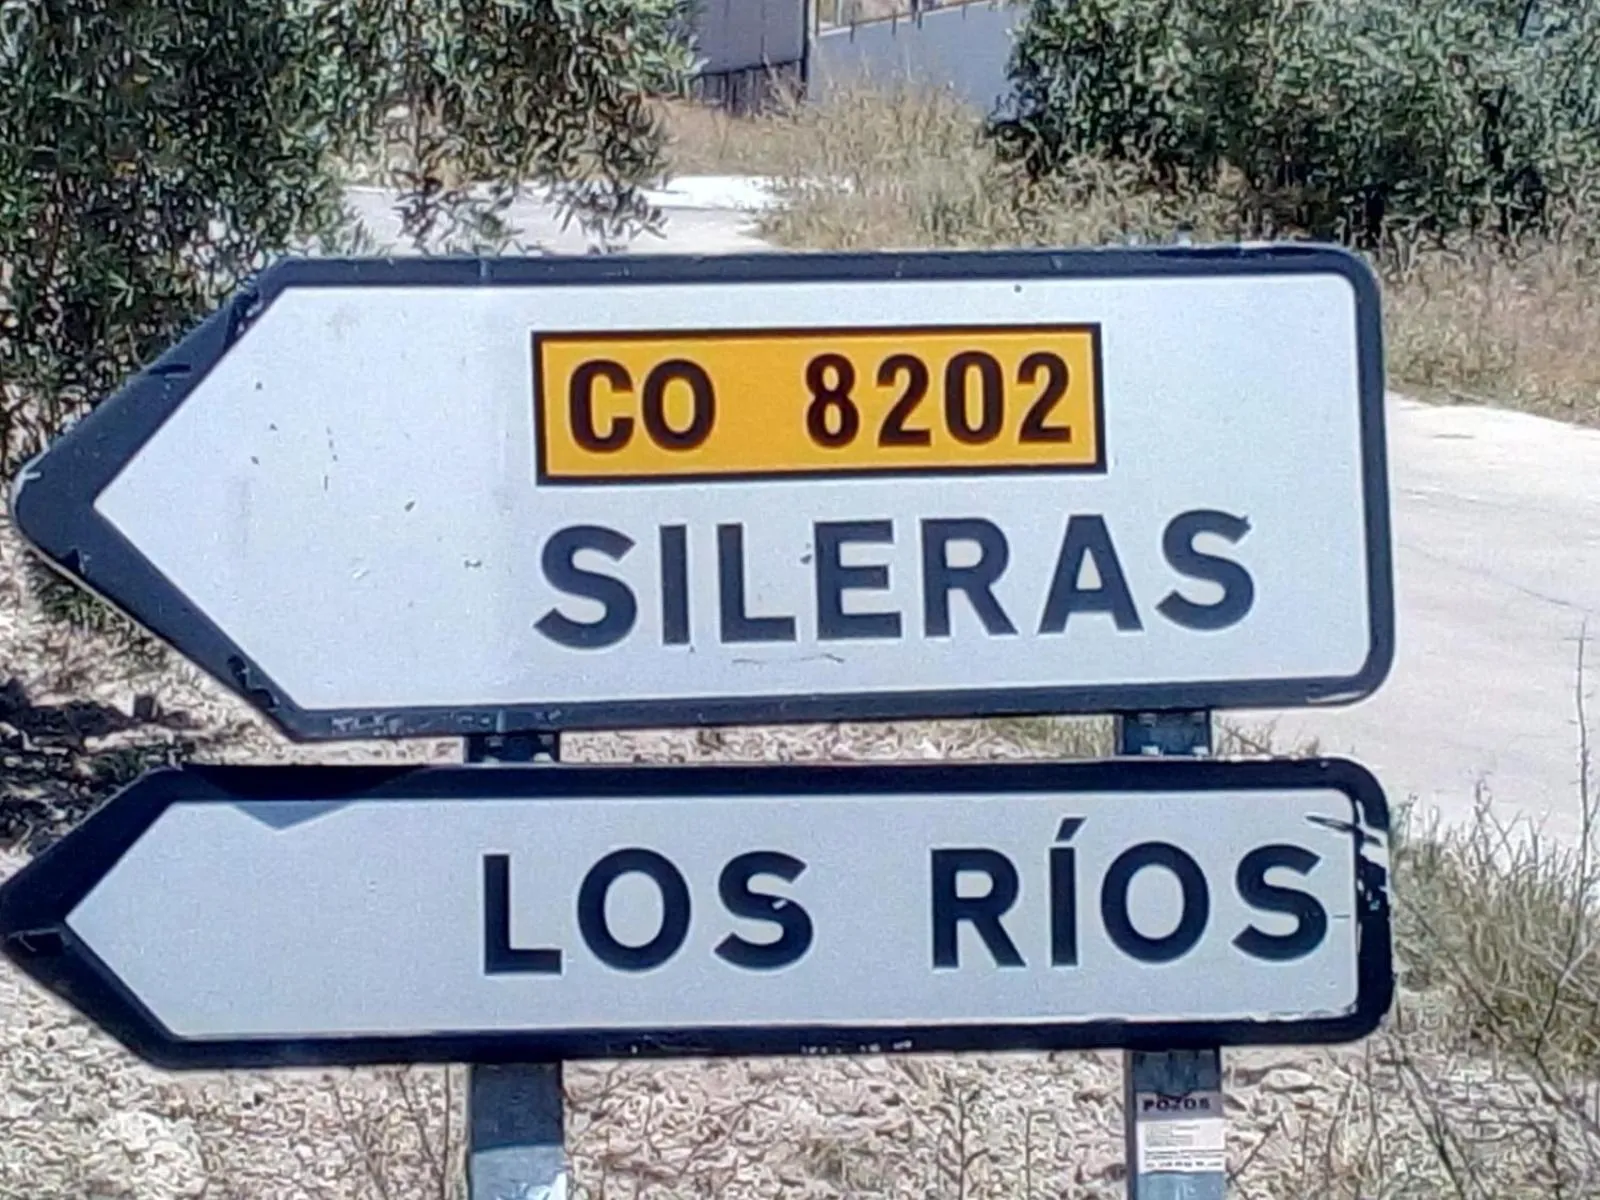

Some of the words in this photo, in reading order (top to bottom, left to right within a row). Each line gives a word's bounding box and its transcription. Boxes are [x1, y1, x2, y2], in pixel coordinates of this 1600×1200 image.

[569, 358, 716, 453] CO
[805, 350, 1072, 449] 8202
[534, 509, 1255, 649] SILERAS
[483, 846, 814, 976] LOS
[930, 817, 1328, 970] RÍOS
